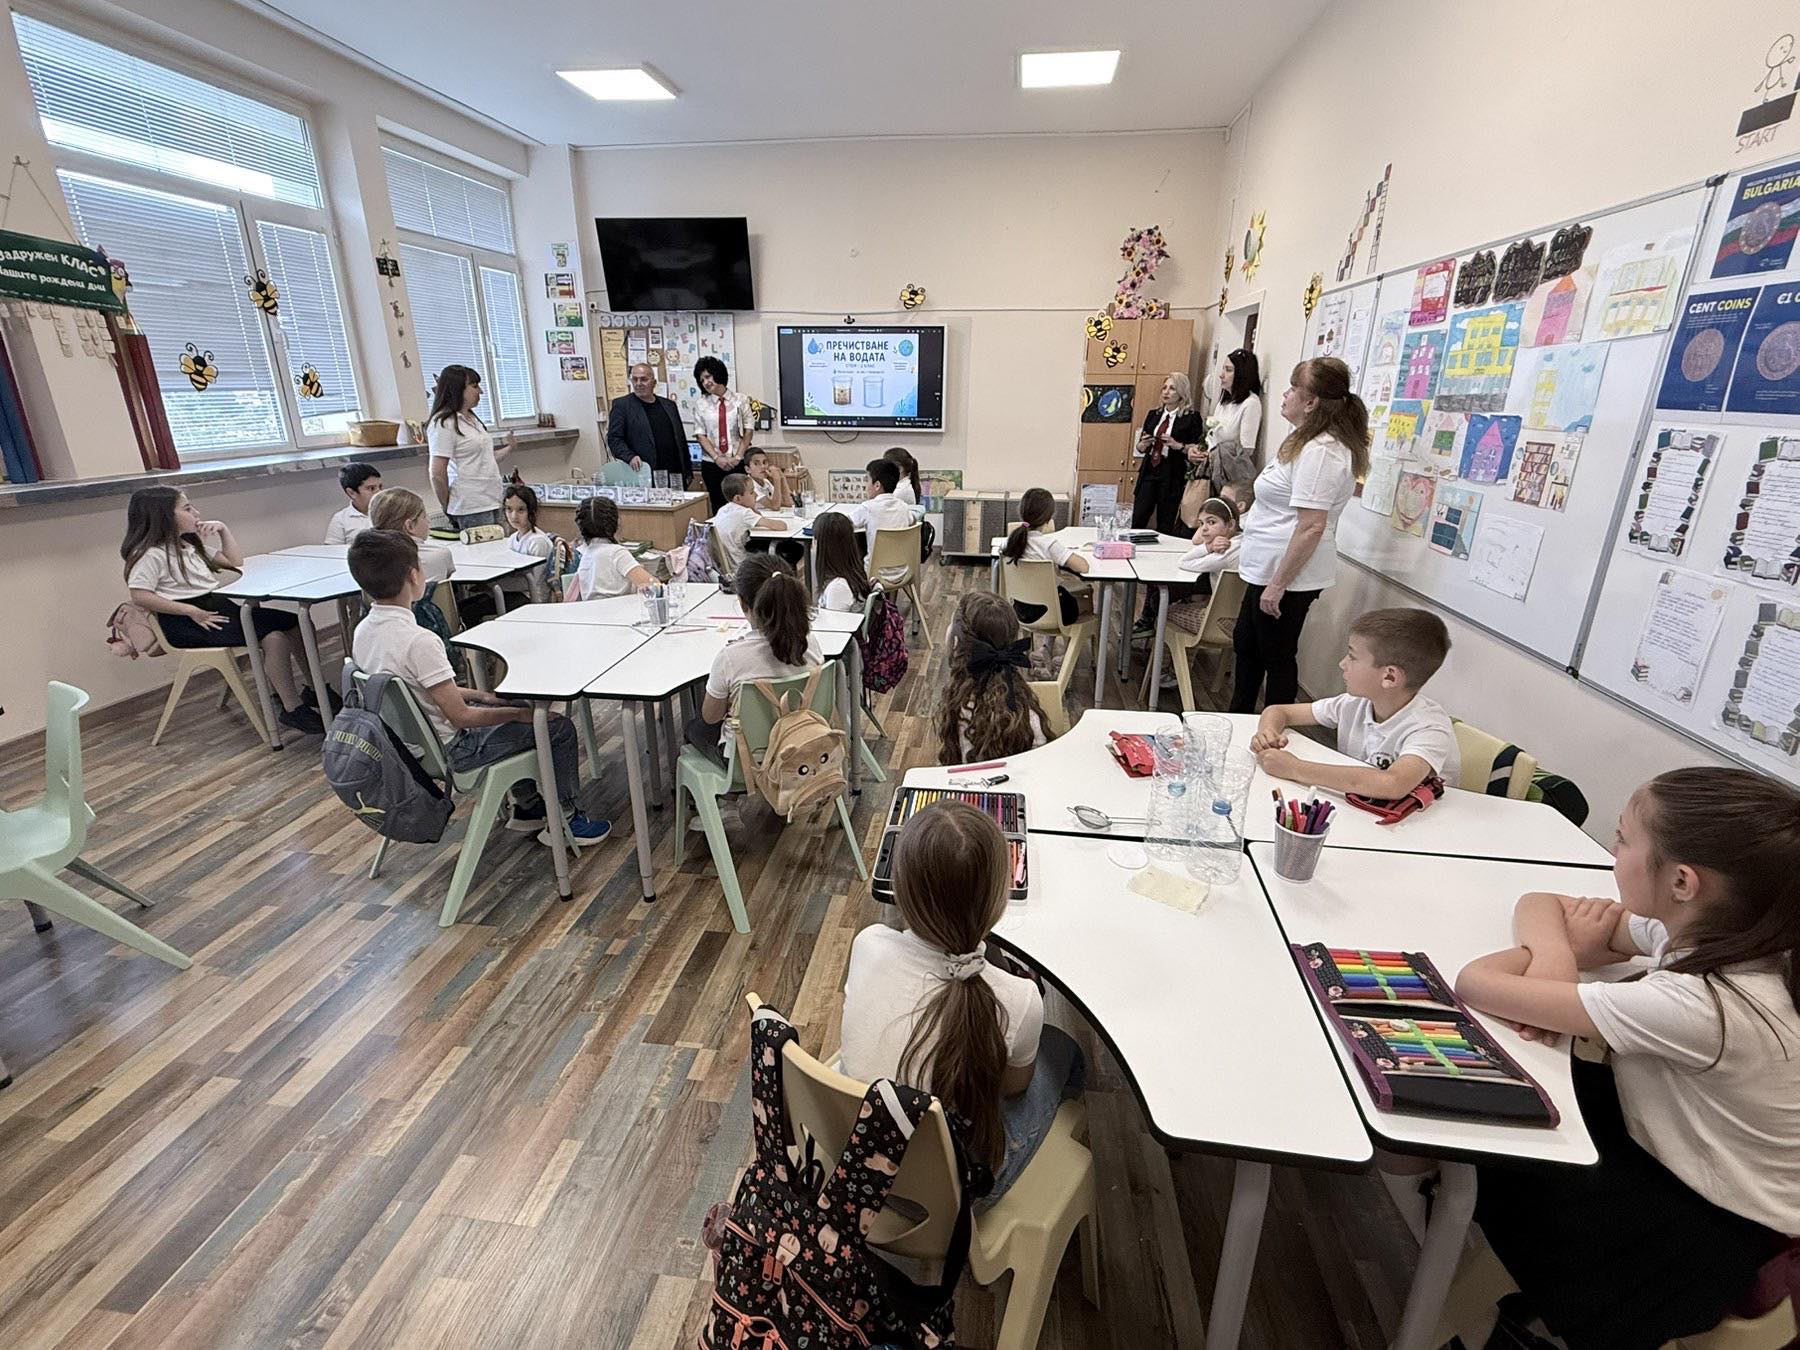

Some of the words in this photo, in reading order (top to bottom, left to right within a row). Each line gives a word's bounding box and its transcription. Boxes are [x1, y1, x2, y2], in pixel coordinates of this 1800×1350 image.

[1736, 124, 1782, 153] START
[0, 265, 37, 281] ашите
[1689, 302, 1717, 314] CENT
[1717, 298, 1752, 311] COINS
[826, 340, 889, 350] ПРЕЧИСТВАНЕ
[833, 352, 846, 362] НА
[849, 352, 886, 363] ВОДАТА
